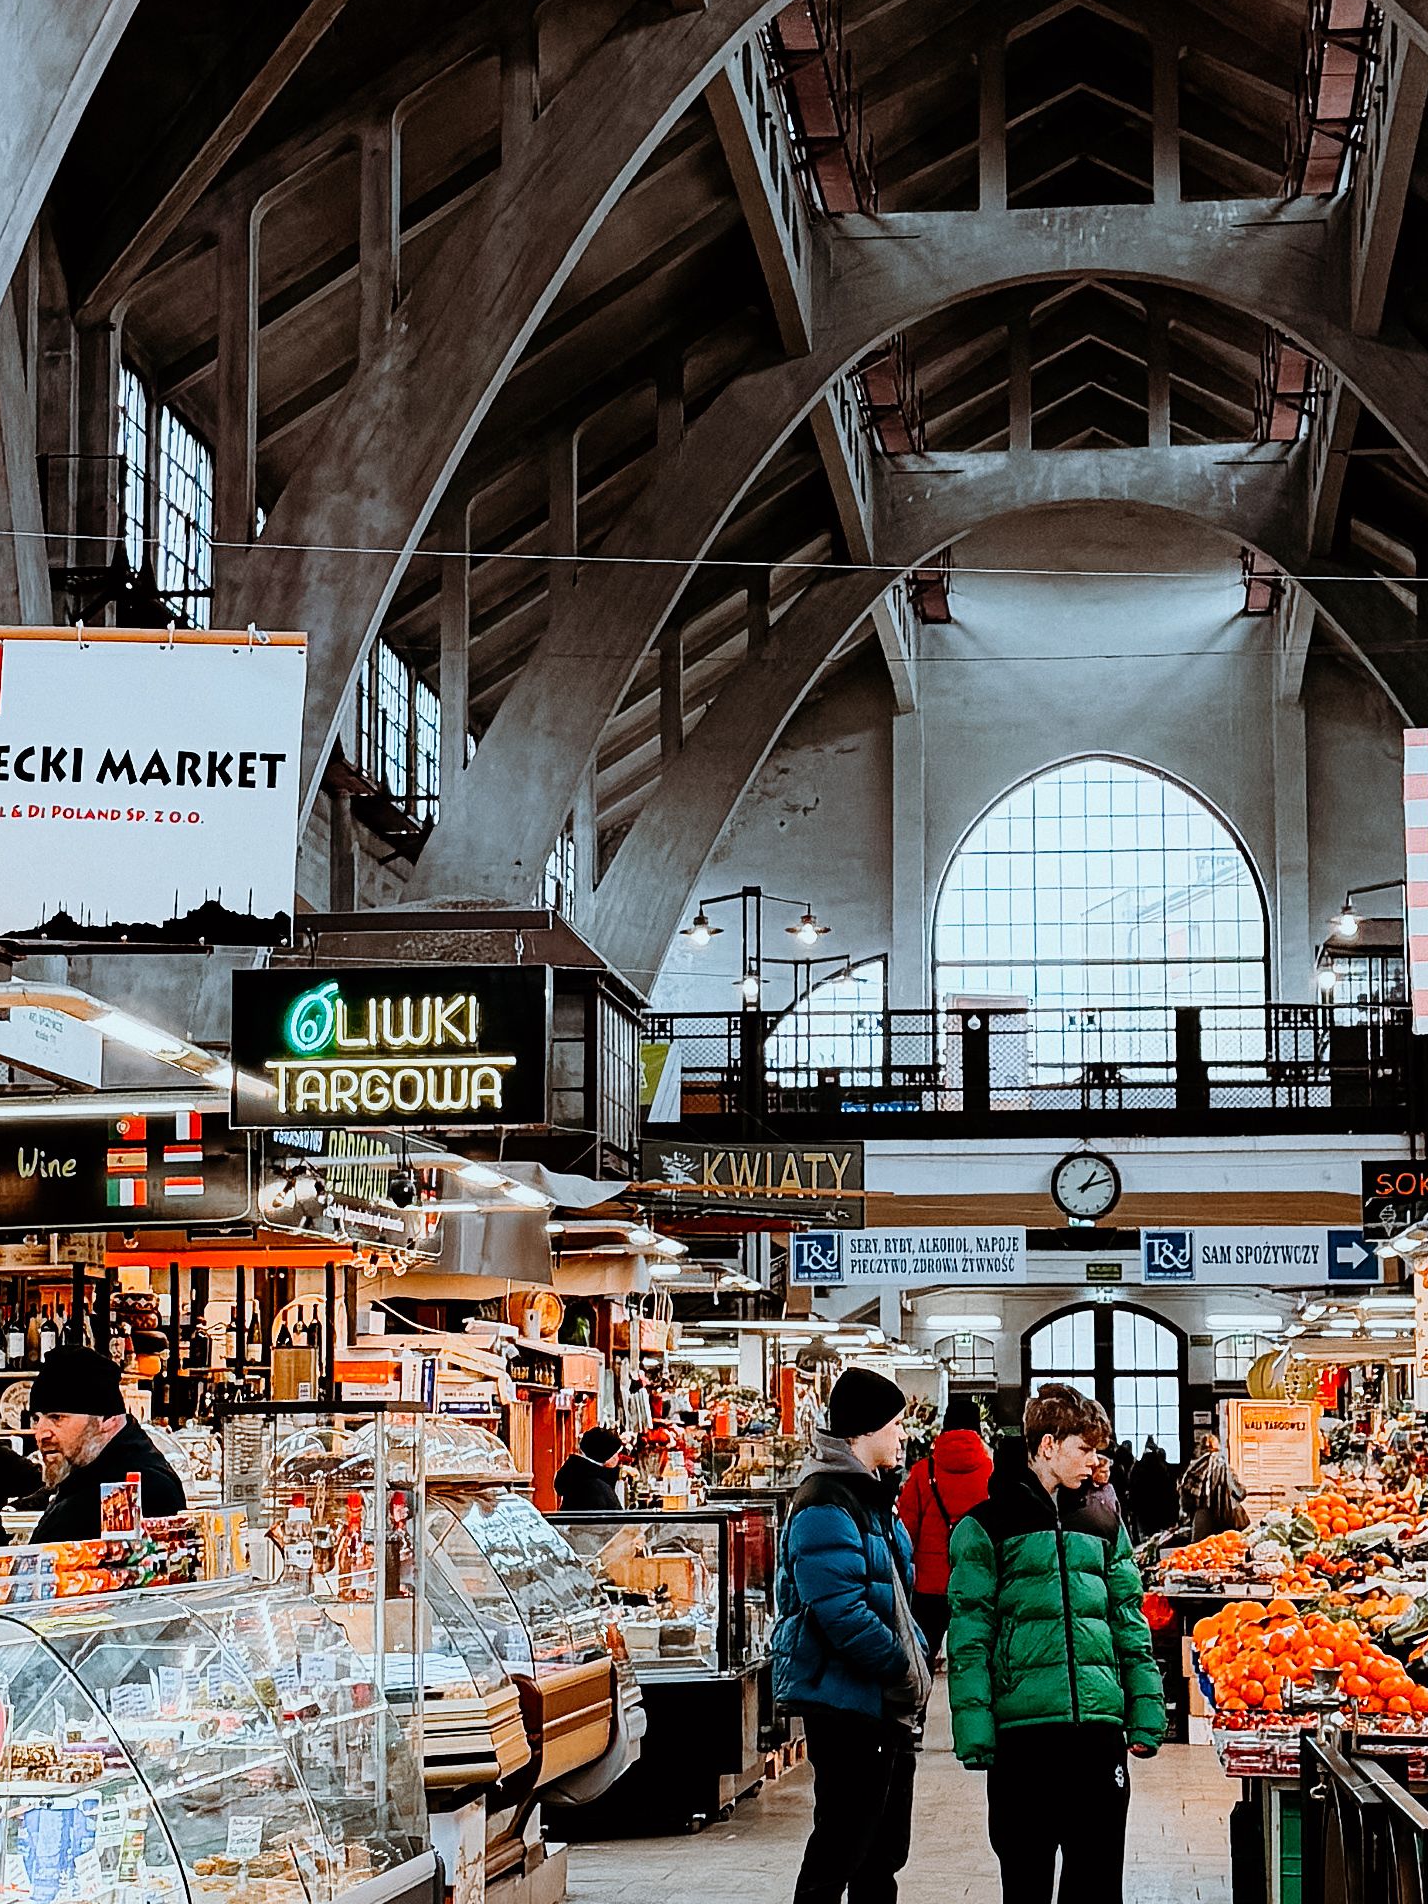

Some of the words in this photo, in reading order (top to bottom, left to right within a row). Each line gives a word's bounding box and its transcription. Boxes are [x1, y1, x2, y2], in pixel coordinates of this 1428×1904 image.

[95, 748, 286, 789] MARKET
[11, 804, 23, 818] &
[288, 980, 479, 1051] OLIWKI
[265, 1055, 517, 1113] TARGOWA
[18, 1147, 78, 1180] Wine
[702, 1149, 853, 1200] KWIATY
[796, 1232, 839, 1271] T&J
[850, 1238, 881, 1255] SERY,
[976, 1237, 1019, 1252] NAPOJE
[914, 1258, 958, 1274] ZDROWA
[962, 1254, 1015, 1273] ŻYWNOŚĆ
[1146, 1231, 1192, 1270] T&J
[1203, 1245, 1231, 1264] SAM
[1236, 1241, 1320, 1264] SPOŻYWCZY
